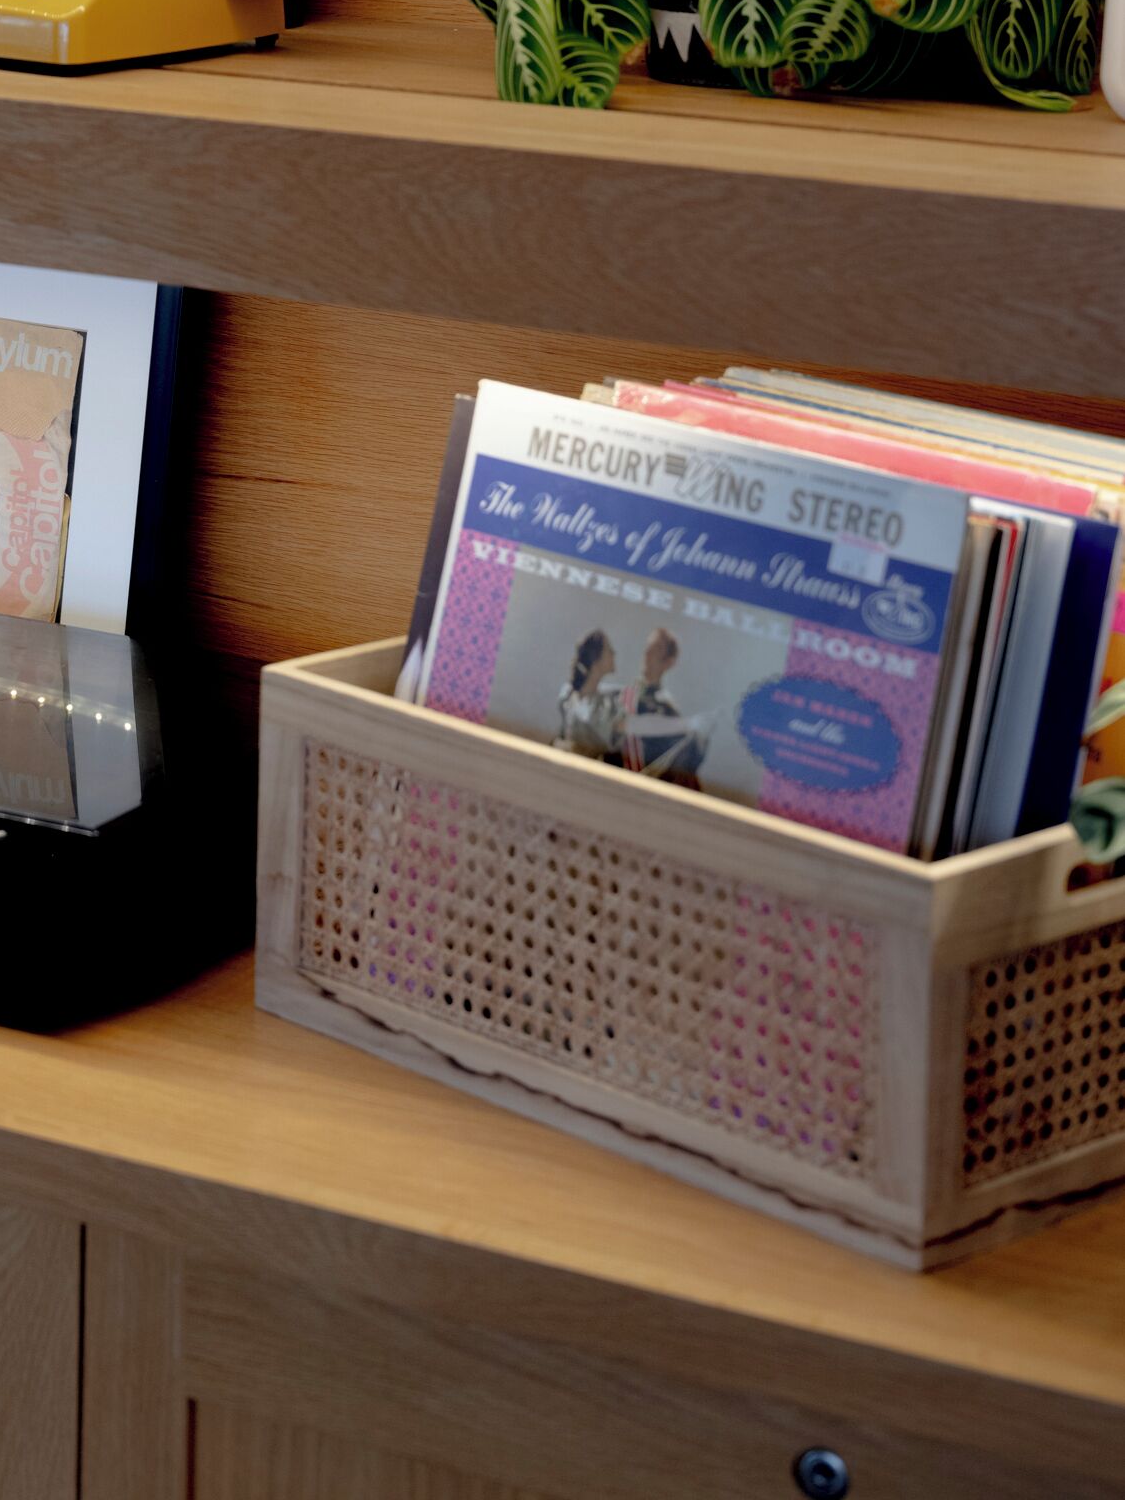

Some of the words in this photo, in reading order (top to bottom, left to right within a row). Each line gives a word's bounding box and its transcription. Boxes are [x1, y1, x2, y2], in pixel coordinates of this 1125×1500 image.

[1, 469, 29, 572] Capitol
[19, 450, 62, 602] Capitol
[478, 479, 525, 520] The
[530, 491, 620, 555] Waltzes
[624, 520, 662, 567] of
[646, 526, 758, 582] Johann
[760, 551, 862, 610] Strauss
[527, 426, 661, 487] MERCURY
[787, 487, 905, 548] STEREO
[471, 538, 675, 612] VIENNESE
